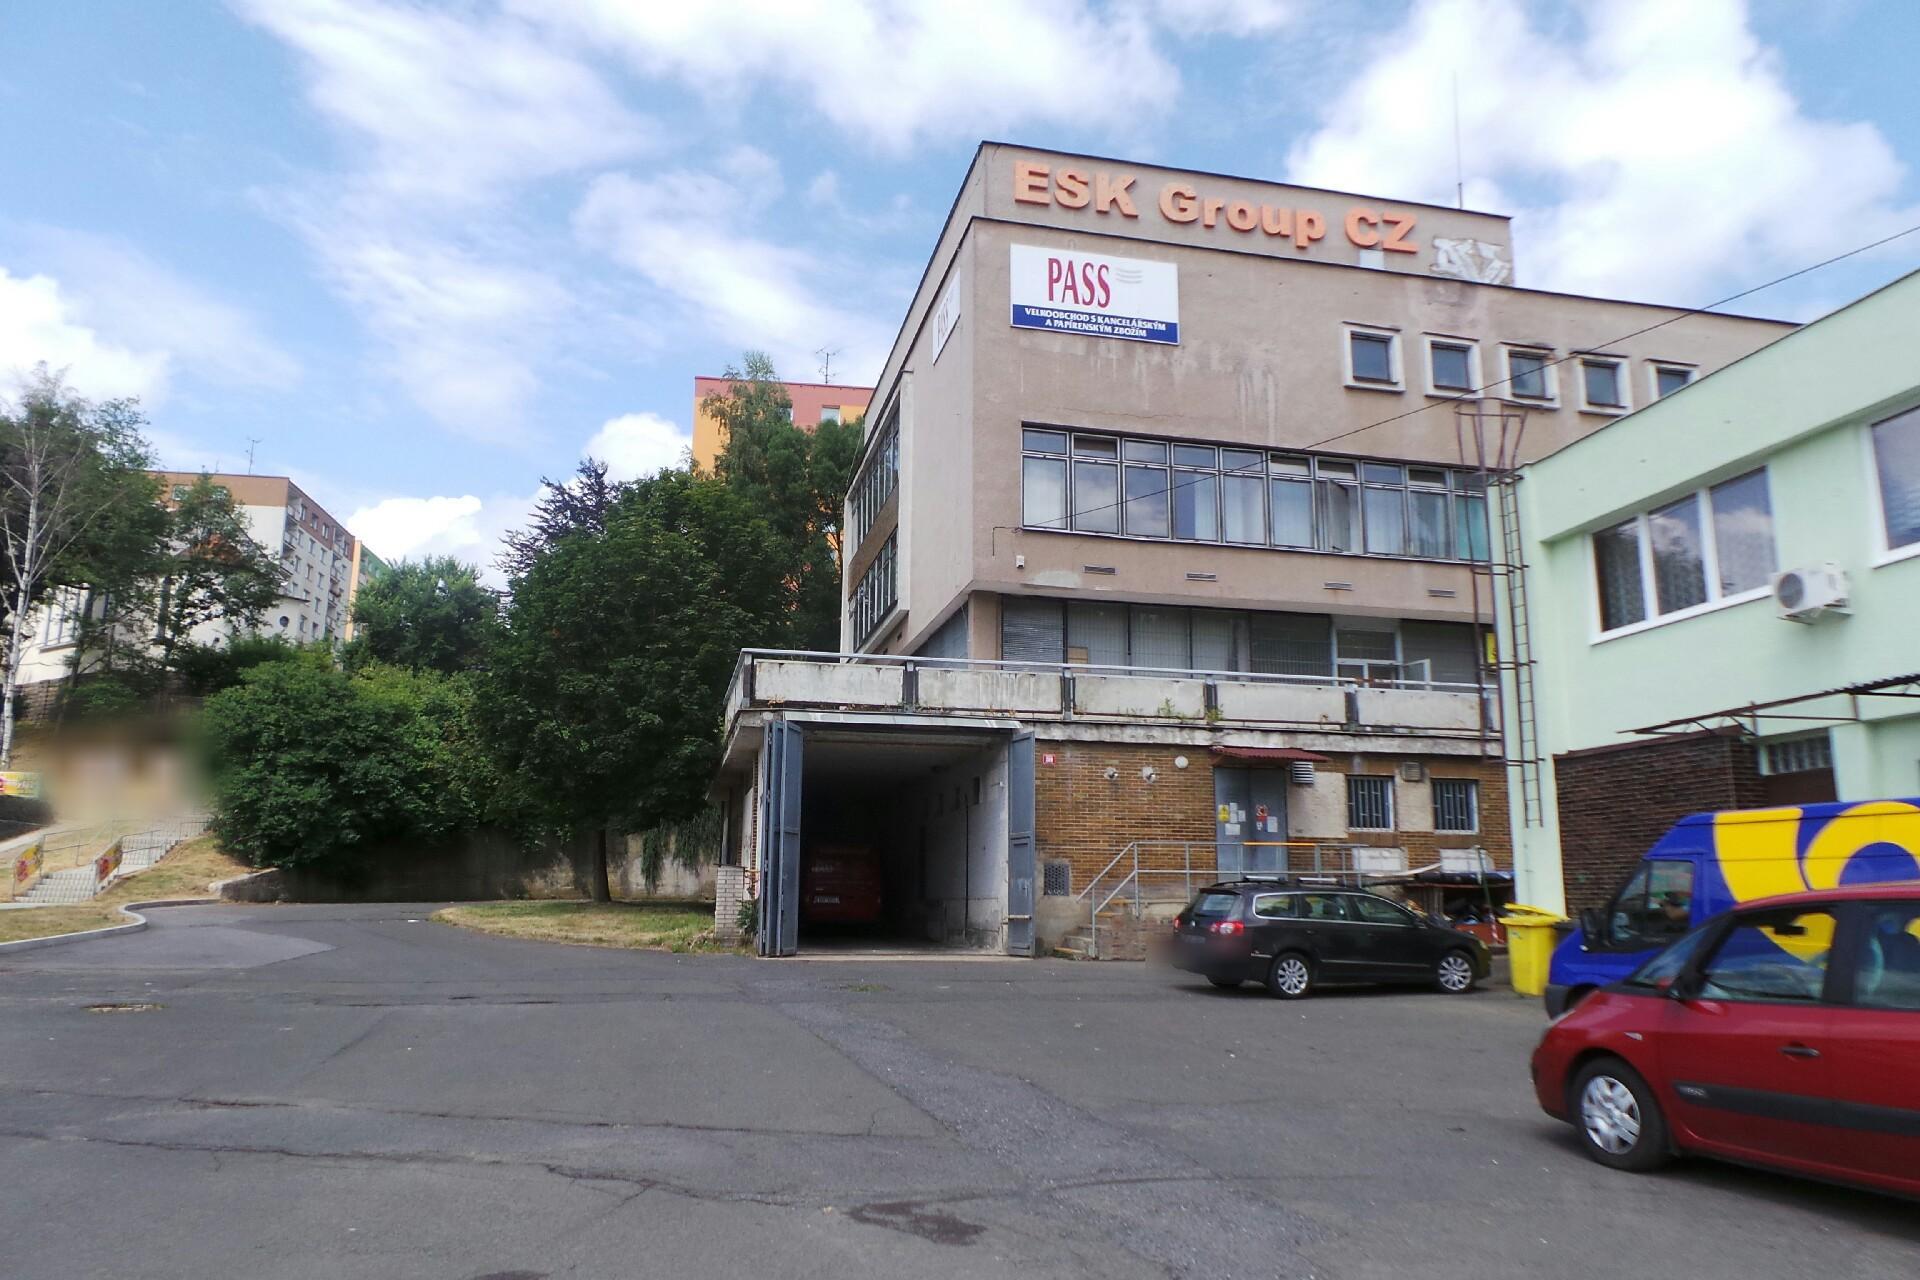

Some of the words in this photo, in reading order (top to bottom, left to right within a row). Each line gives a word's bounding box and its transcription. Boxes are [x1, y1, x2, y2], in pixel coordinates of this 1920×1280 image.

[1014, 162, 1138, 218] ESK
[1159, 184, 1326, 248] Group
[1345, 207, 1418, 254] CZ
[1048, 258, 1111, 308] PASS
[1025, 308, 1089, 323] VELKOOBCHOD
[1091, 315, 1096, 323] S
[1097, 317, 1166, 331] KANCELÁŘSKÝM
[1054, 320, 1112, 334] PAPÍRENSKÝM
[1113, 326, 1147, 337] ZBOŽÍM
